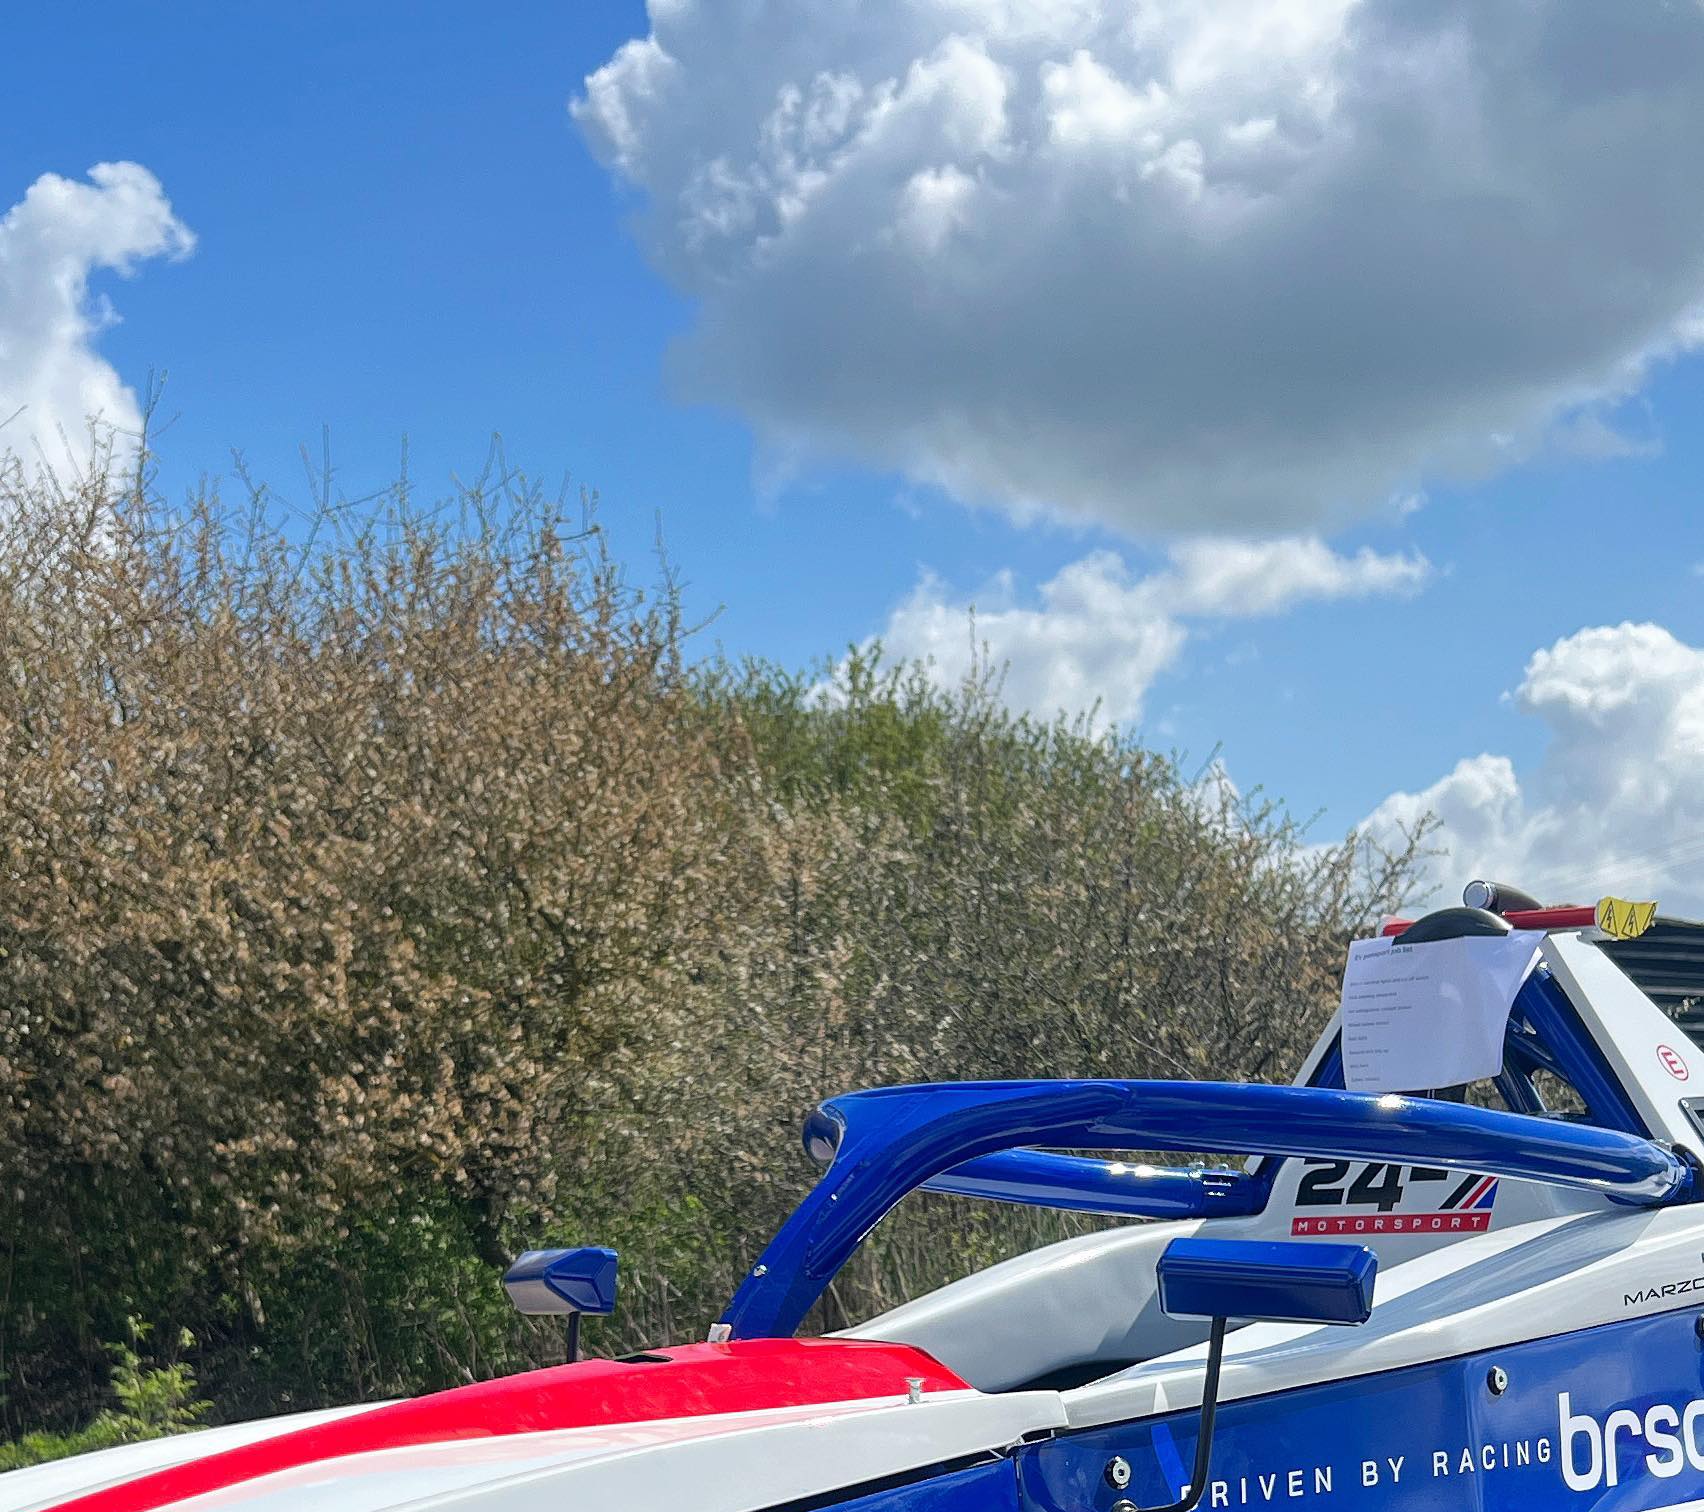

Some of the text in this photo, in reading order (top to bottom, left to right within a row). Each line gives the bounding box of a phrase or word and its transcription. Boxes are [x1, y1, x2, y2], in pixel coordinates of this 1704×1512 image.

[1297, 1217, 1481, 1233] MOTORSPORT
[1361, 1455, 1405, 1487] BY
[1433, 1438, 1551, 1477] RACING
